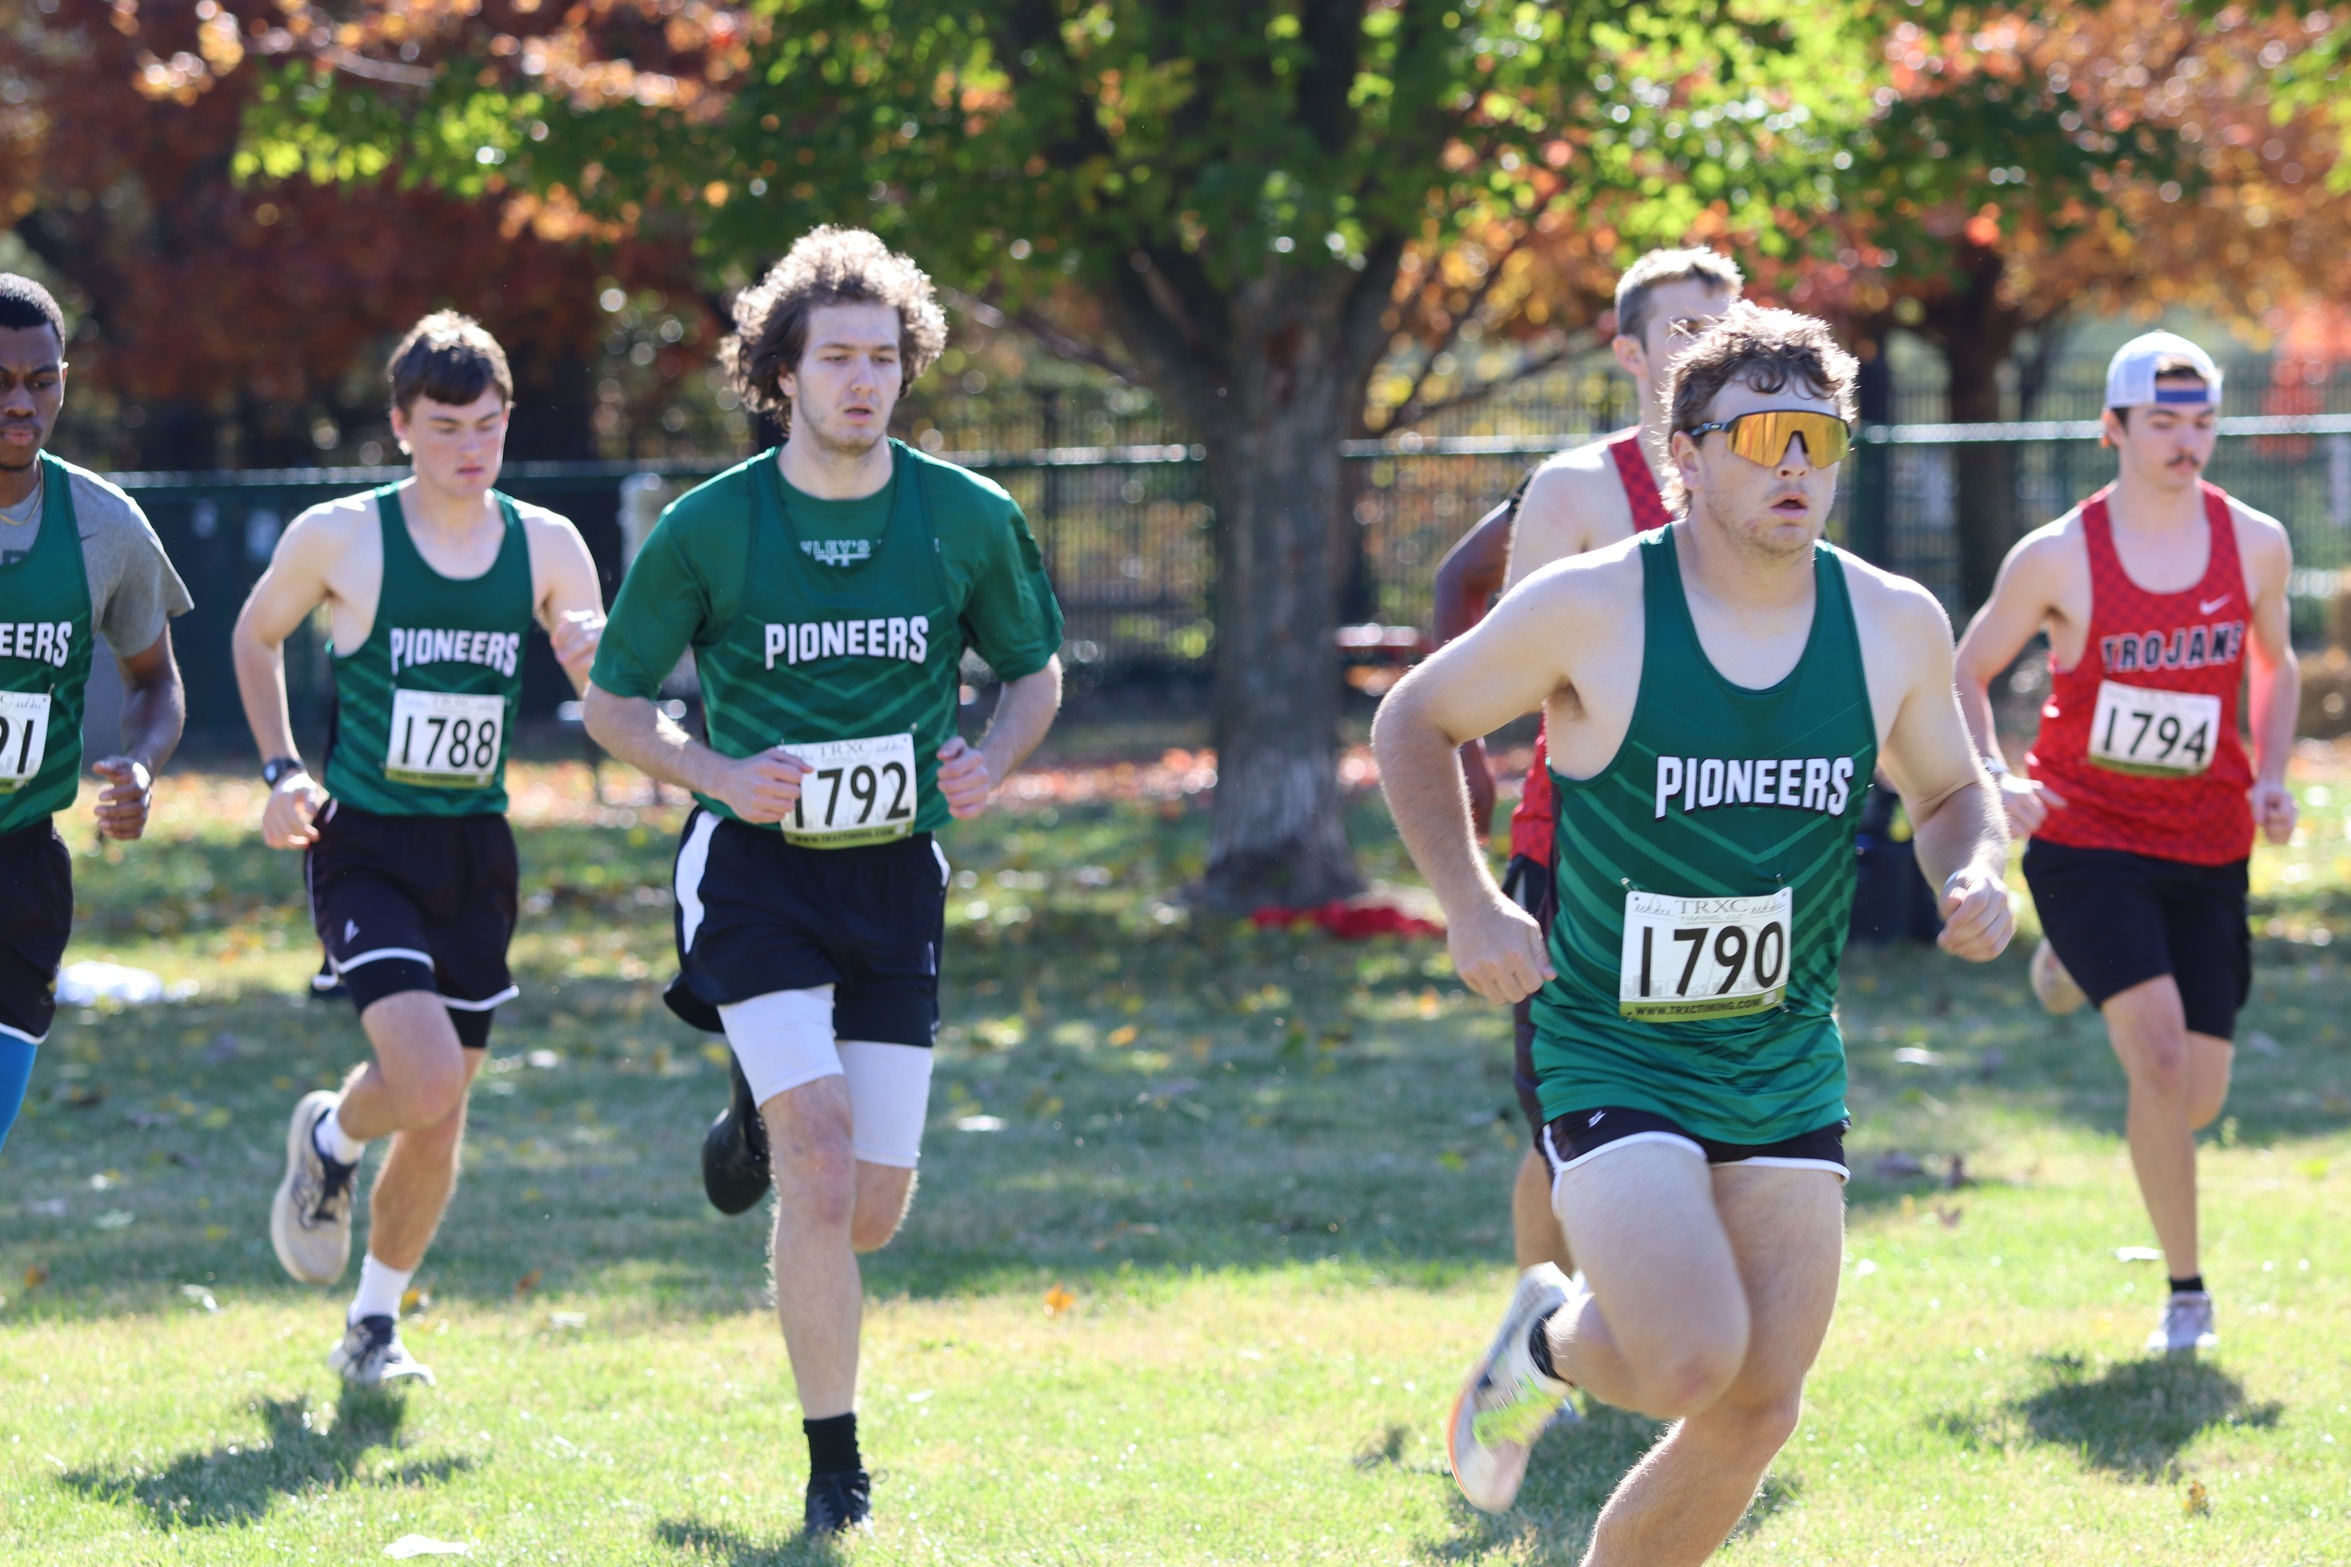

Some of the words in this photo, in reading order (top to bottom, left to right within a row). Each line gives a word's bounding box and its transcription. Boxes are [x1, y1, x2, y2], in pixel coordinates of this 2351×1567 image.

[0, 621, 73, 668] EERS
[390, 628, 520, 678] PIONEERS
[765, 615, 929, 670] PIONEERS
[2100, 620, 2245, 673] TROJANS
[402, 715, 496, 768] 1788
[2104, 707, 2209, 762] 1794
[1654, 756, 1855, 821] PIONEERS
[1675, 899, 1748, 914] TRXC
[1640, 921, 1784, 998] 1790
[1635, 999, 1762, 1016] WWW.TRXCTIMING.COM
